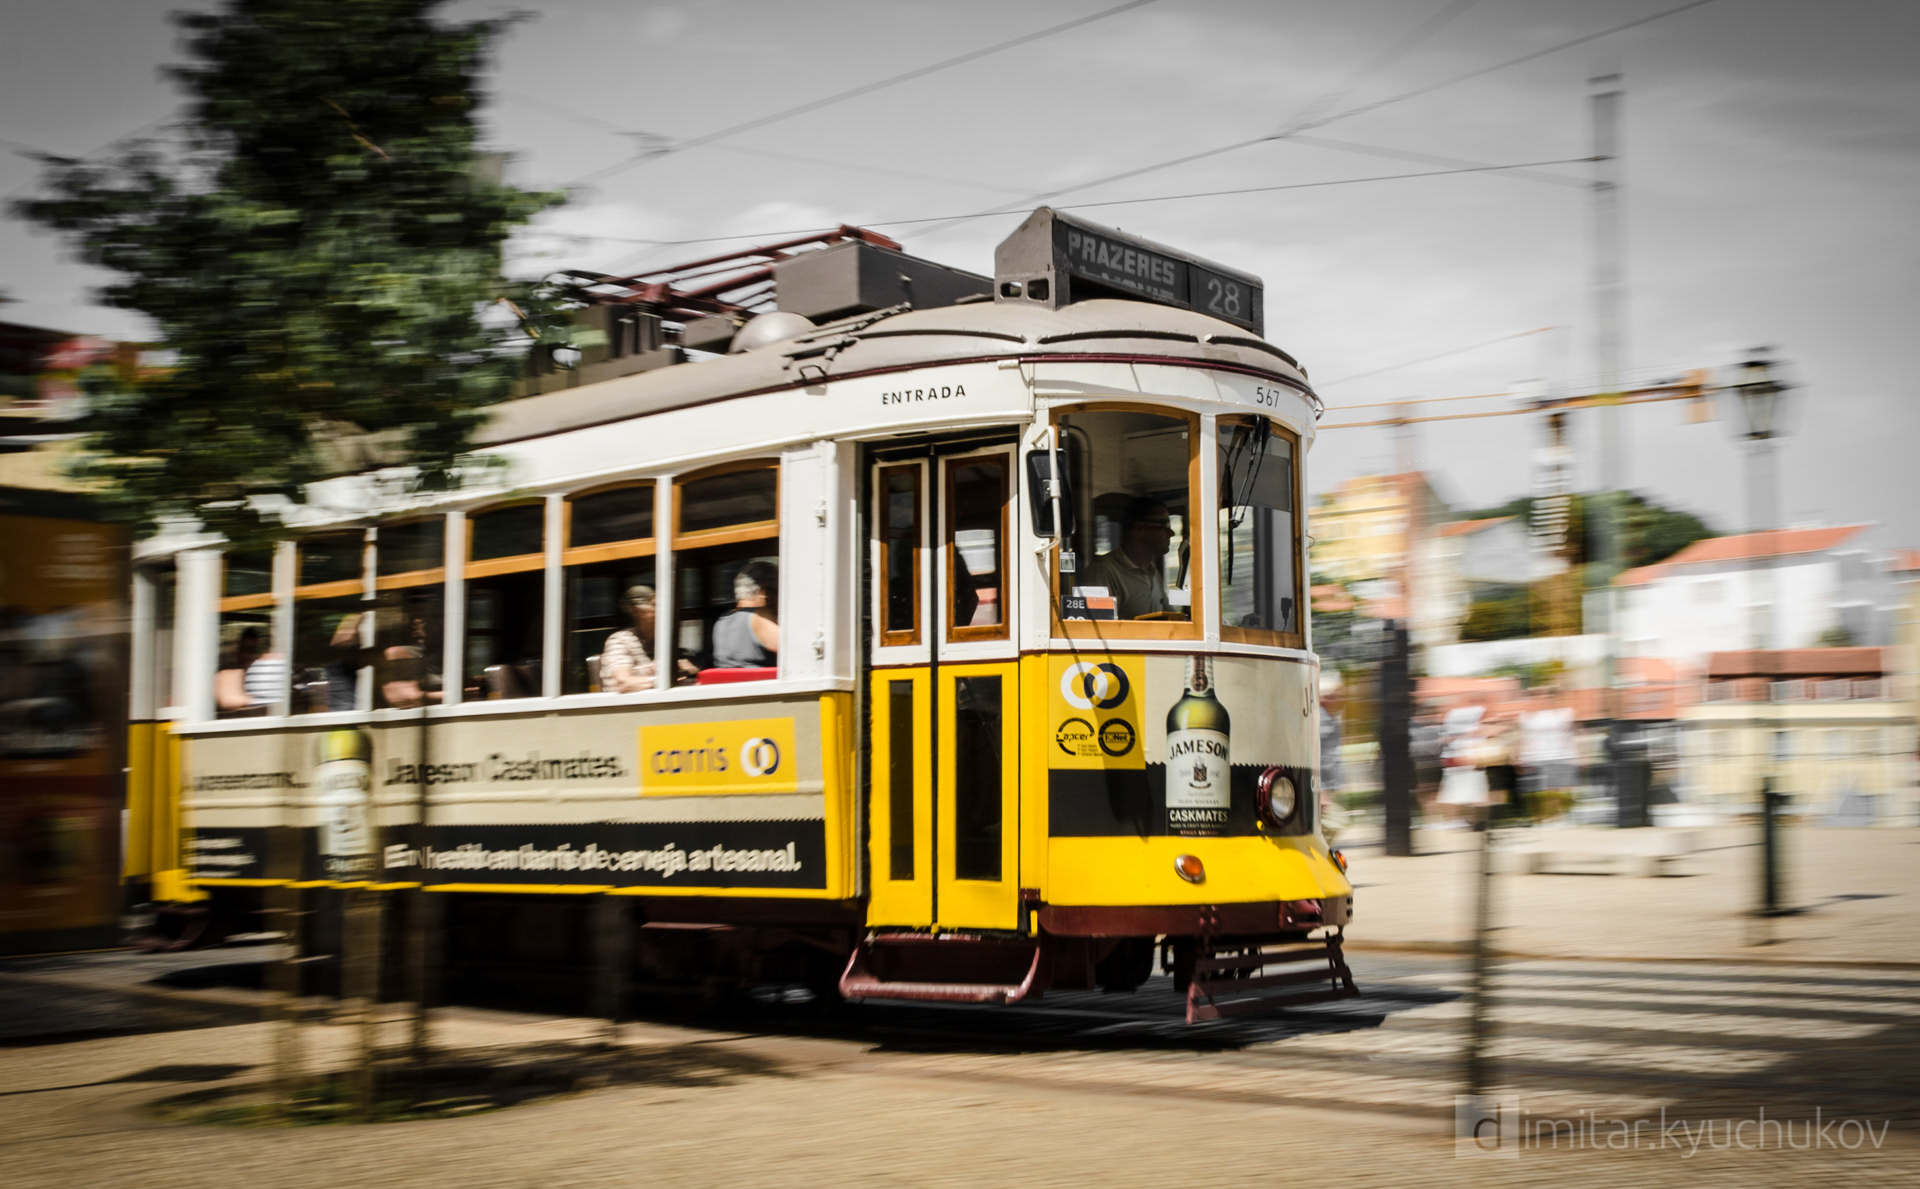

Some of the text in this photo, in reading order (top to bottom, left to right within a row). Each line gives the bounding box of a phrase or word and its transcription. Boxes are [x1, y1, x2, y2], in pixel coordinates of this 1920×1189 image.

[1067, 230, 1175, 286] PRAZERES
[1207, 278, 1240, 316] 28
[882, 384, 966, 405] ENTRADA
[1256, 386, 1280, 408] 567
[1066, 599, 1085, 609] 28E
[1170, 739, 1228, 761] JAMESON
[1169, 809, 1228, 822] CASKMATES
[607, 842, 688, 878] cerveja
[688, 841, 802, 871] artesanal.
